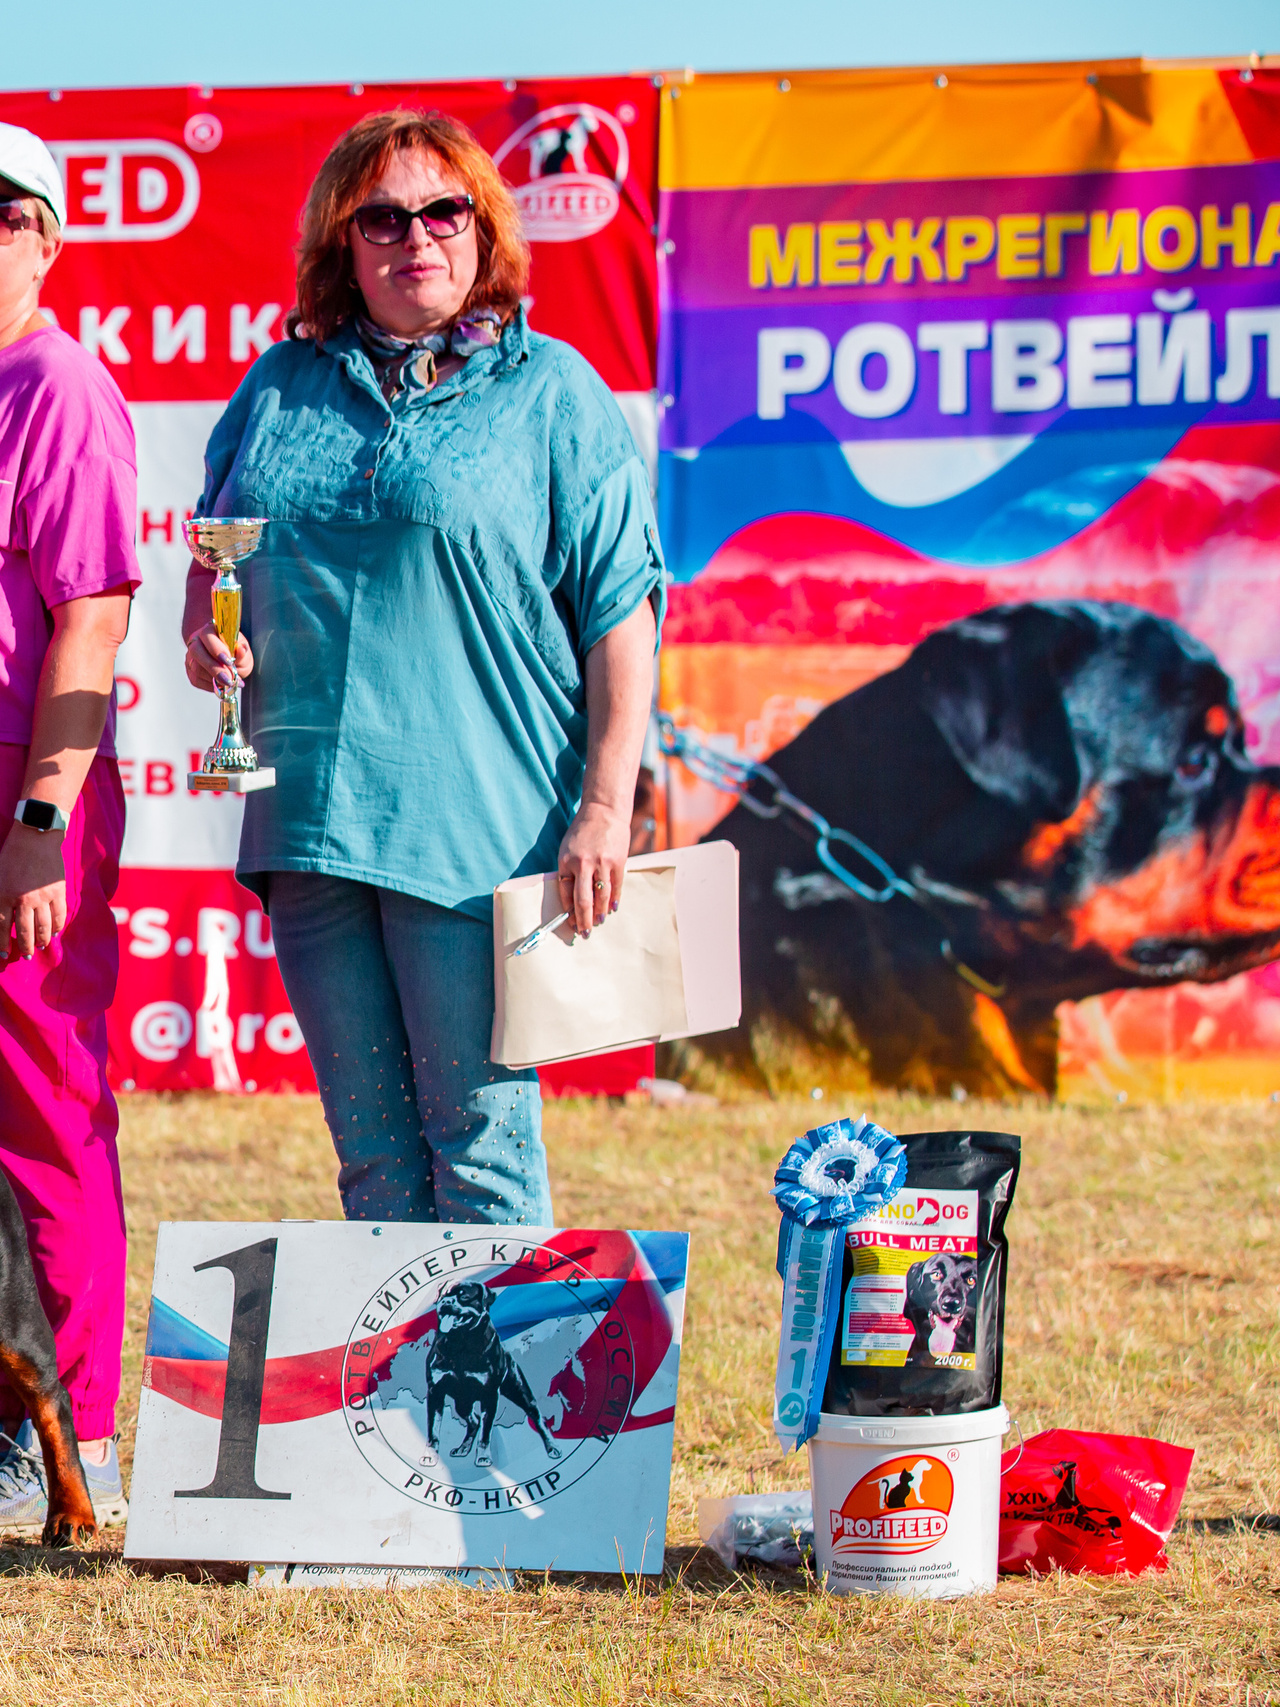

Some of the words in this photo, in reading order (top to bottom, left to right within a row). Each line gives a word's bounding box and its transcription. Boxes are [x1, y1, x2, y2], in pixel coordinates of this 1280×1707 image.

[152, 304, 206, 364] И
[756, 286, 1280, 420] РОТВЕЙЛ
[848, 1232, 900, 1248] BULL
[909, 1236, 969, 1252] MEAT
[789, 1227, 826, 1343] CHAMPION
[347, 1247, 468, 1437] РОТВЕЙЛЕР
[490, 1243, 586, 1288] КЛУБ
[590, 1296, 631, 1444] РОССИИ
[934, 1355, 962, 1366] 2000
[173, 1237, 292, 1500] 1
[791, 1347, 808, 1389] 1
[403, 1471, 561, 1510] РКФ-НКПР
[830, 1509, 948, 1540] PROFIFEED
[831, 1560, 917, 1574] Профессиональный
[919, 1561, 953, 1573] подход
[831, 1570, 874, 1582] кормлению
[875, 1573, 907, 1582] Ваших
[908, 1569, 960, 1582] питомцев!
